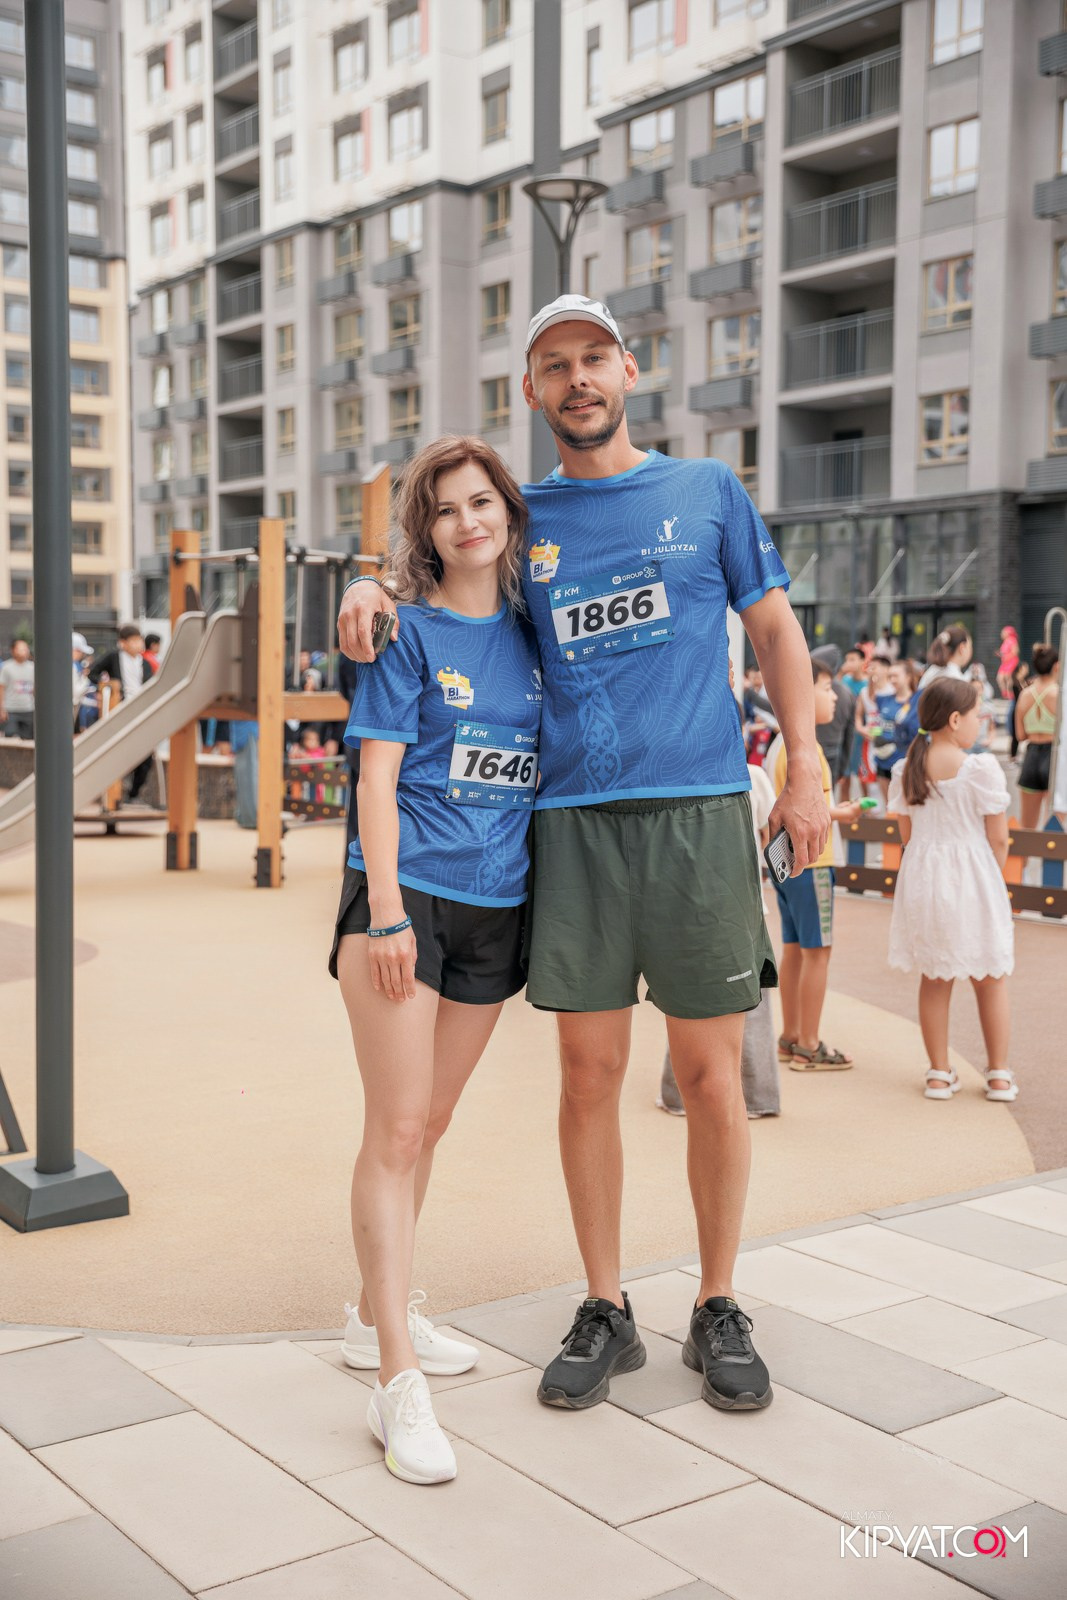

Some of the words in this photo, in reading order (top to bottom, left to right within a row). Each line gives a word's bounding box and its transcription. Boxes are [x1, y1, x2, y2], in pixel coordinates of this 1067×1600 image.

[641, 548, 651, 556] BI
[653, 544, 698, 554] JULDYZAI
[533, 562, 544, 574] BI
[622, 570, 644, 581] GROUP
[553, 589, 562, 600] 5
[564, 586, 580, 598] KM
[566, 589, 654, 638] 1866
[447, 687, 459, 697] BI
[460, 726, 470, 736] 5
[472, 729, 488, 739] KM
[463, 749, 534, 784] 1646
